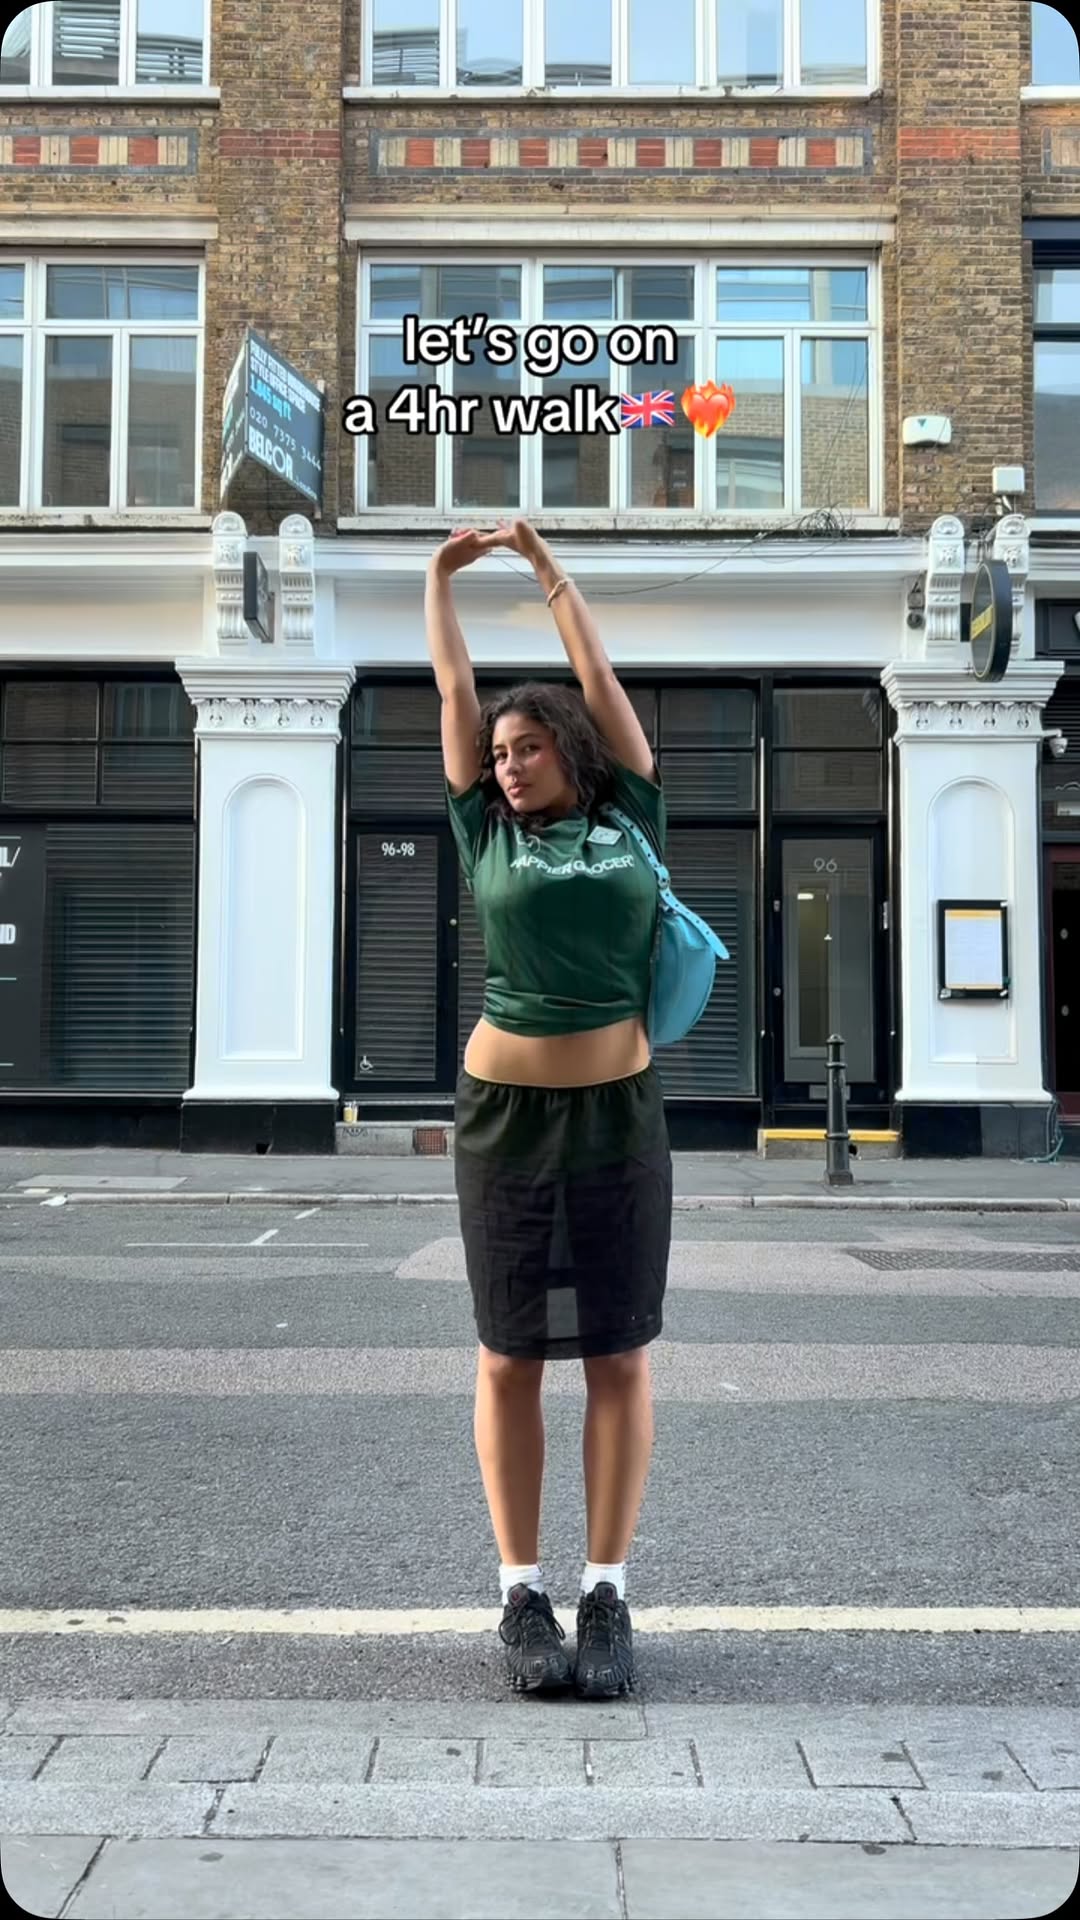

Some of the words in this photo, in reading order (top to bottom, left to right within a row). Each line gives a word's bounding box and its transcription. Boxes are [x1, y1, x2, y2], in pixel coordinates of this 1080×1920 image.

[248, 424, 293, 481] BELCOR
[249, 405, 268, 429] 020
[273, 424, 296, 451] 7375
[301, 445, 322, 472] 3444
[381, 842, 416, 857] 96-98
[813, 857, 838, 873] 96
